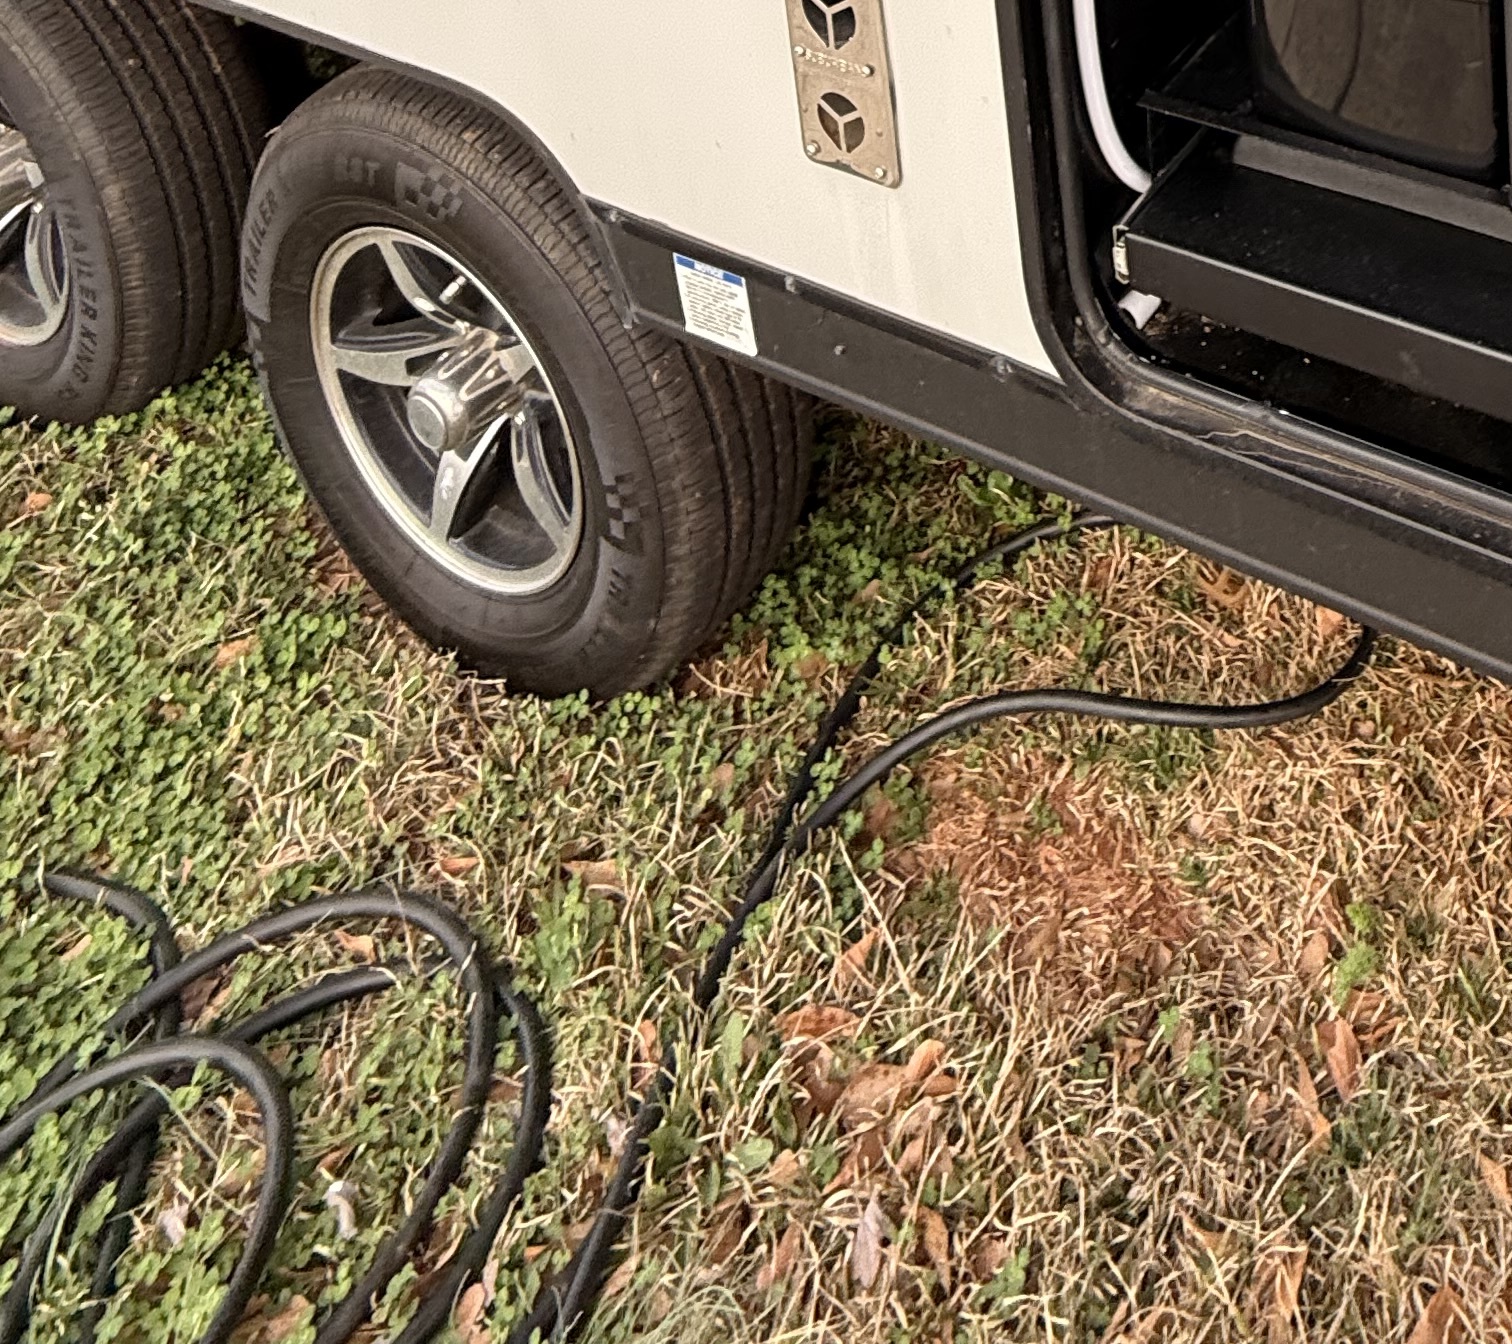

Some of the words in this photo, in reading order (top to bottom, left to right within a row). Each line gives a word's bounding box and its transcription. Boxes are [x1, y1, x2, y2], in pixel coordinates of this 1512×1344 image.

[57, 198, 98, 321] TRAILER
[243, 188, 278, 297] TRAILER
[72, 324, 98, 384] KING
